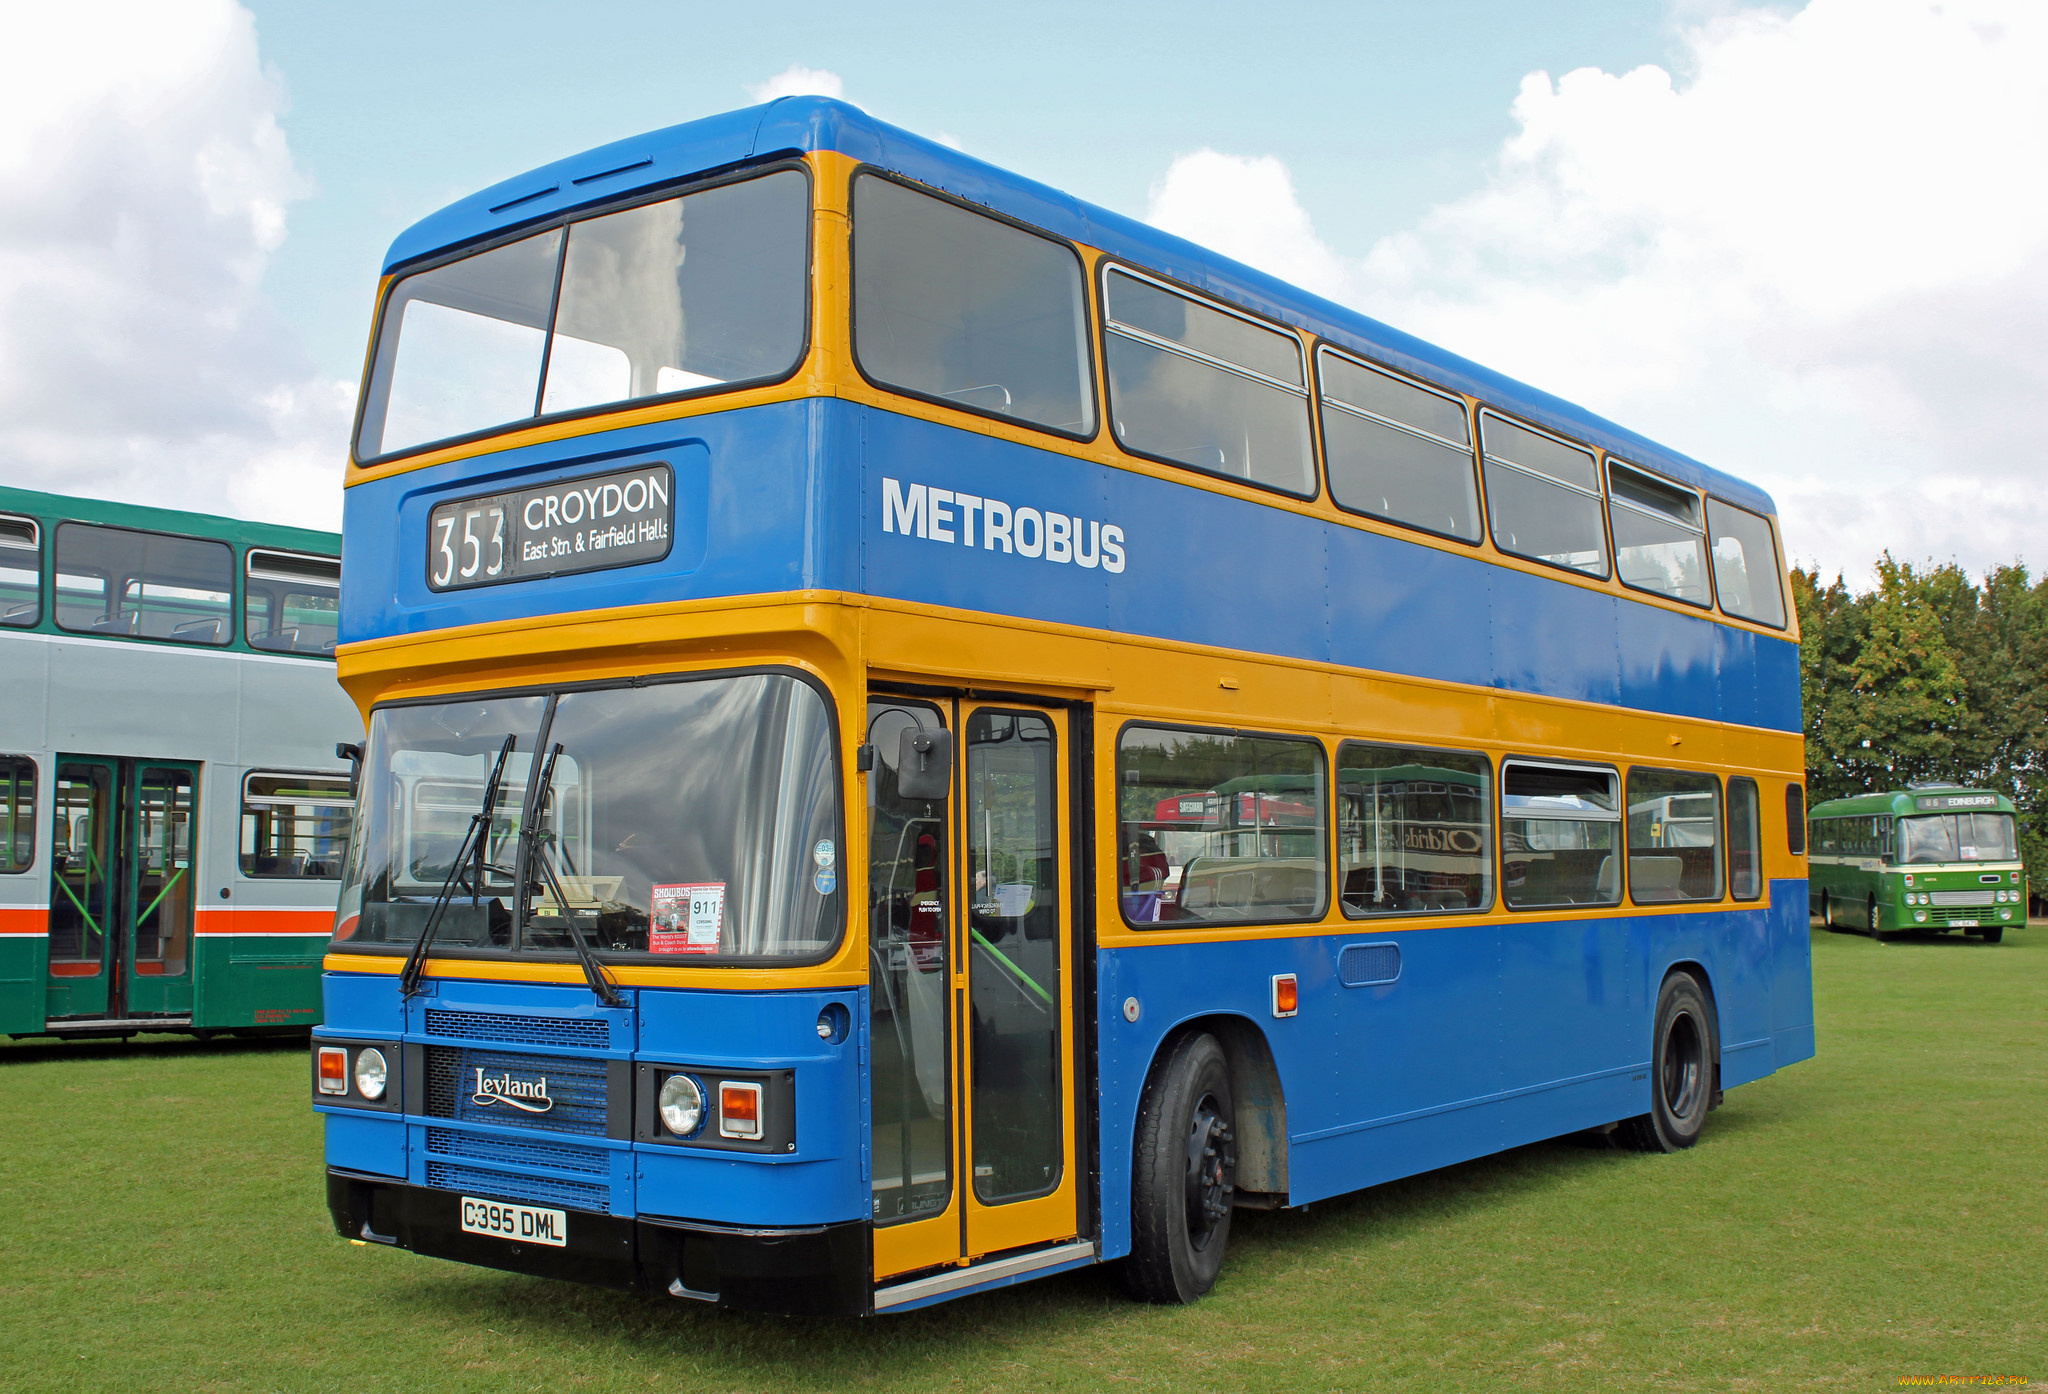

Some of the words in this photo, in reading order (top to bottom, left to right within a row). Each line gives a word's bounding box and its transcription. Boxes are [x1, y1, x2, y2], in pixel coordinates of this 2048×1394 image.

[524, 473, 668, 531] CROYDON
[433, 508, 504, 586] 353
[523, 540, 548, 561] East
[551, 537, 572, 558] Stn.
[575, 535, 585, 553] &
[589, 523, 635, 551] Fairfield
[639, 518, 668, 543] Halls
[882, 477, 1126, 574] METROBUS
[1948, 796, 1995, 806] EDINBURGH
[654, 887, 691, 898] SHOWBUS
[694, 901, 717, 914] 911
[472, 1067, 552, 1113] Leyland
[464, 1202, 514, 1233] C395
[521, 1211, 563, 1241] DML
